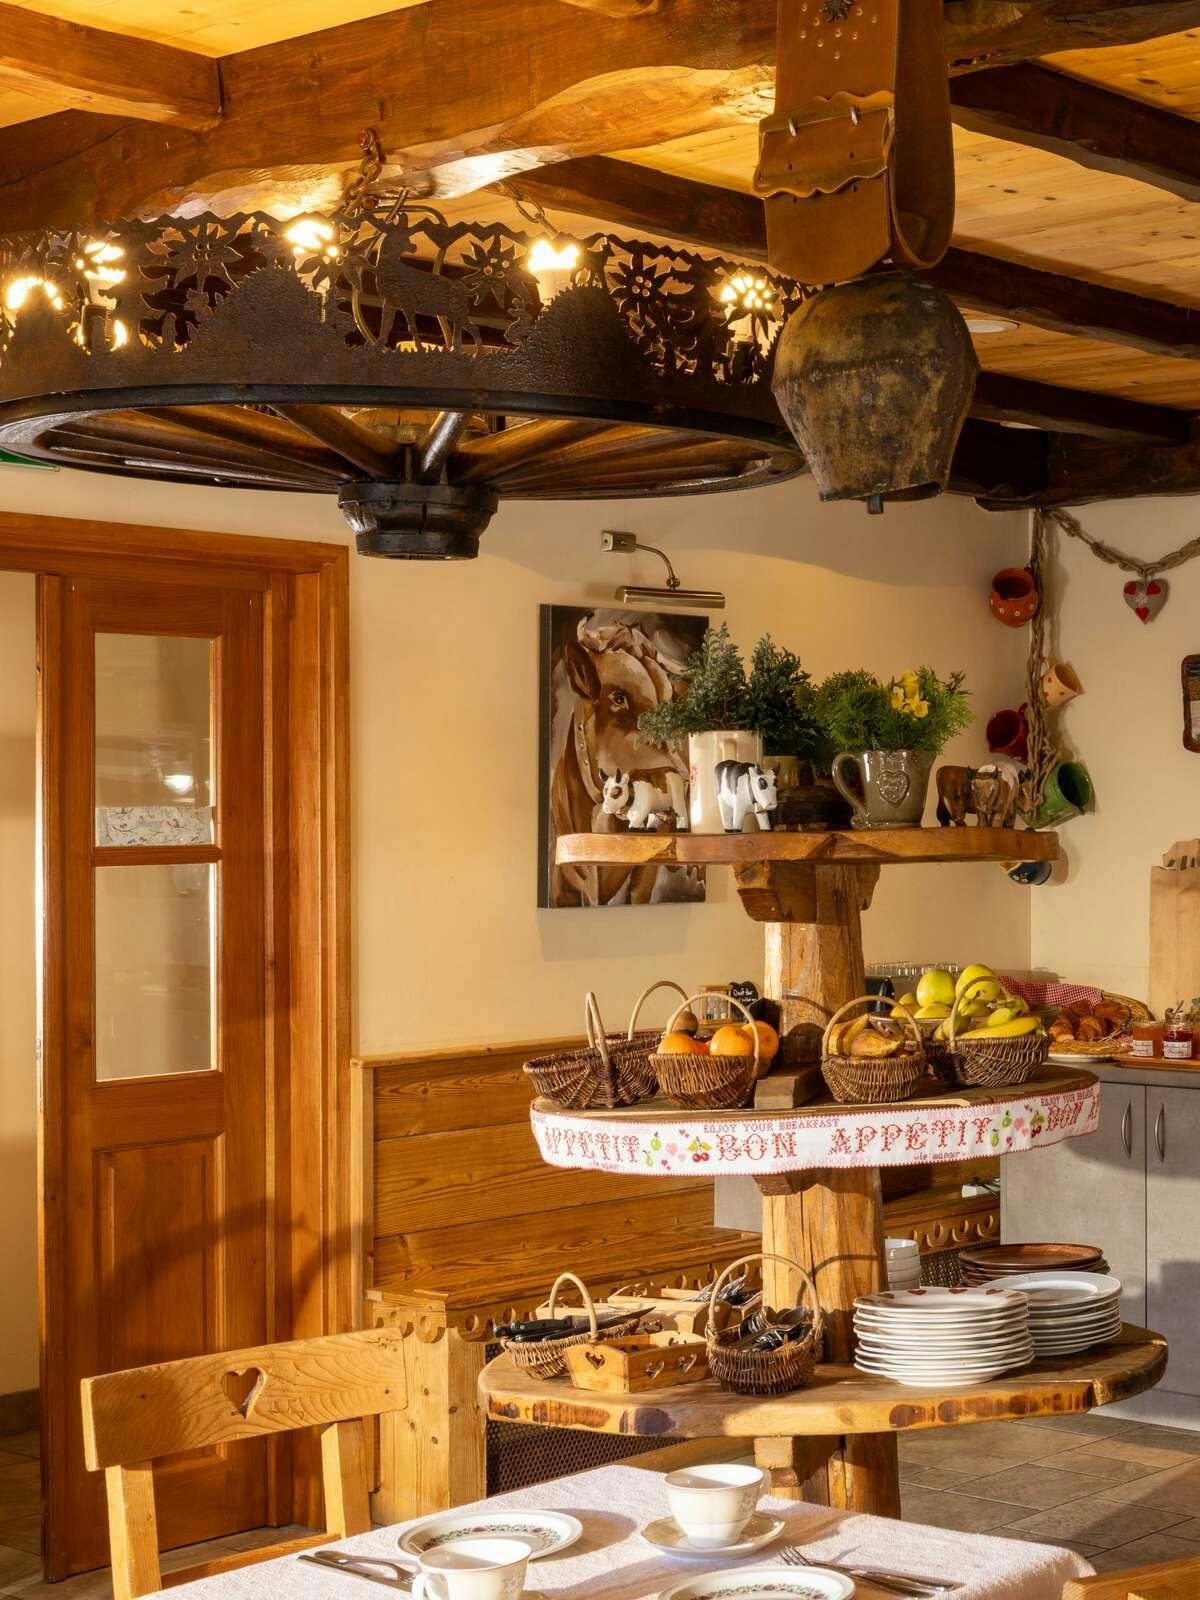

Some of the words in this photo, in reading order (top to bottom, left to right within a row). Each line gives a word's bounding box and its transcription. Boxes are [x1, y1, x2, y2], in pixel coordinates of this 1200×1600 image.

[703, 1123, 738, 1134] ENJOY
[743, 1122, 774, 1133] YOUR
[779, 1118, 841, 1131] BREAKFAST
[1046, 1101, 1083, 1131] BON
[716, 1131, 798, 1162] BON
